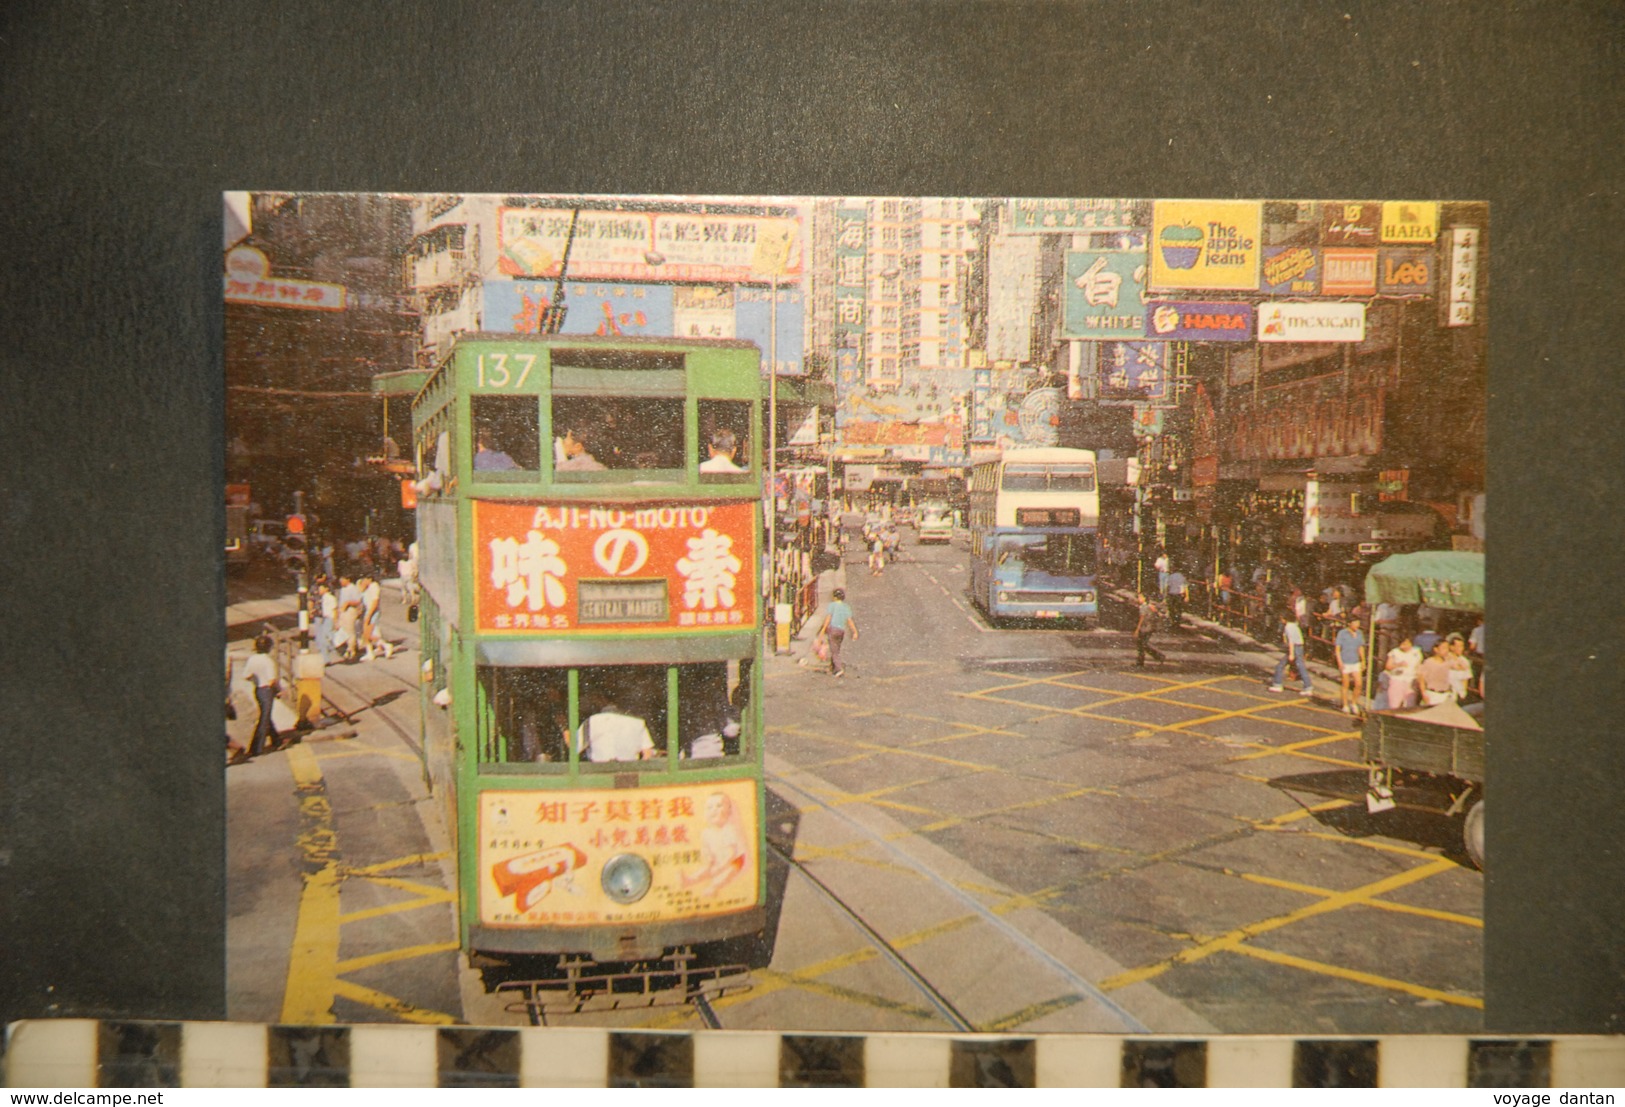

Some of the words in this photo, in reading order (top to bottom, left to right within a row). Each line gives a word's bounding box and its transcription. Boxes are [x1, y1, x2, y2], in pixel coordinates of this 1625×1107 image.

[1207, 221, 1237, 238] The
[1384, 224, 1433, 238] HARA
[1207, 235, 1254, 253] apple
[1205, 250, 1246, 267] jeans
[1385, 258, 1428, 285] Lee
[1085, 315, 1143, 330] WHITE
[1184, 313, 1247, 330] HARA
[1288, 315, 1361, 329] mexican
[478, 353, 537, 388] 137
